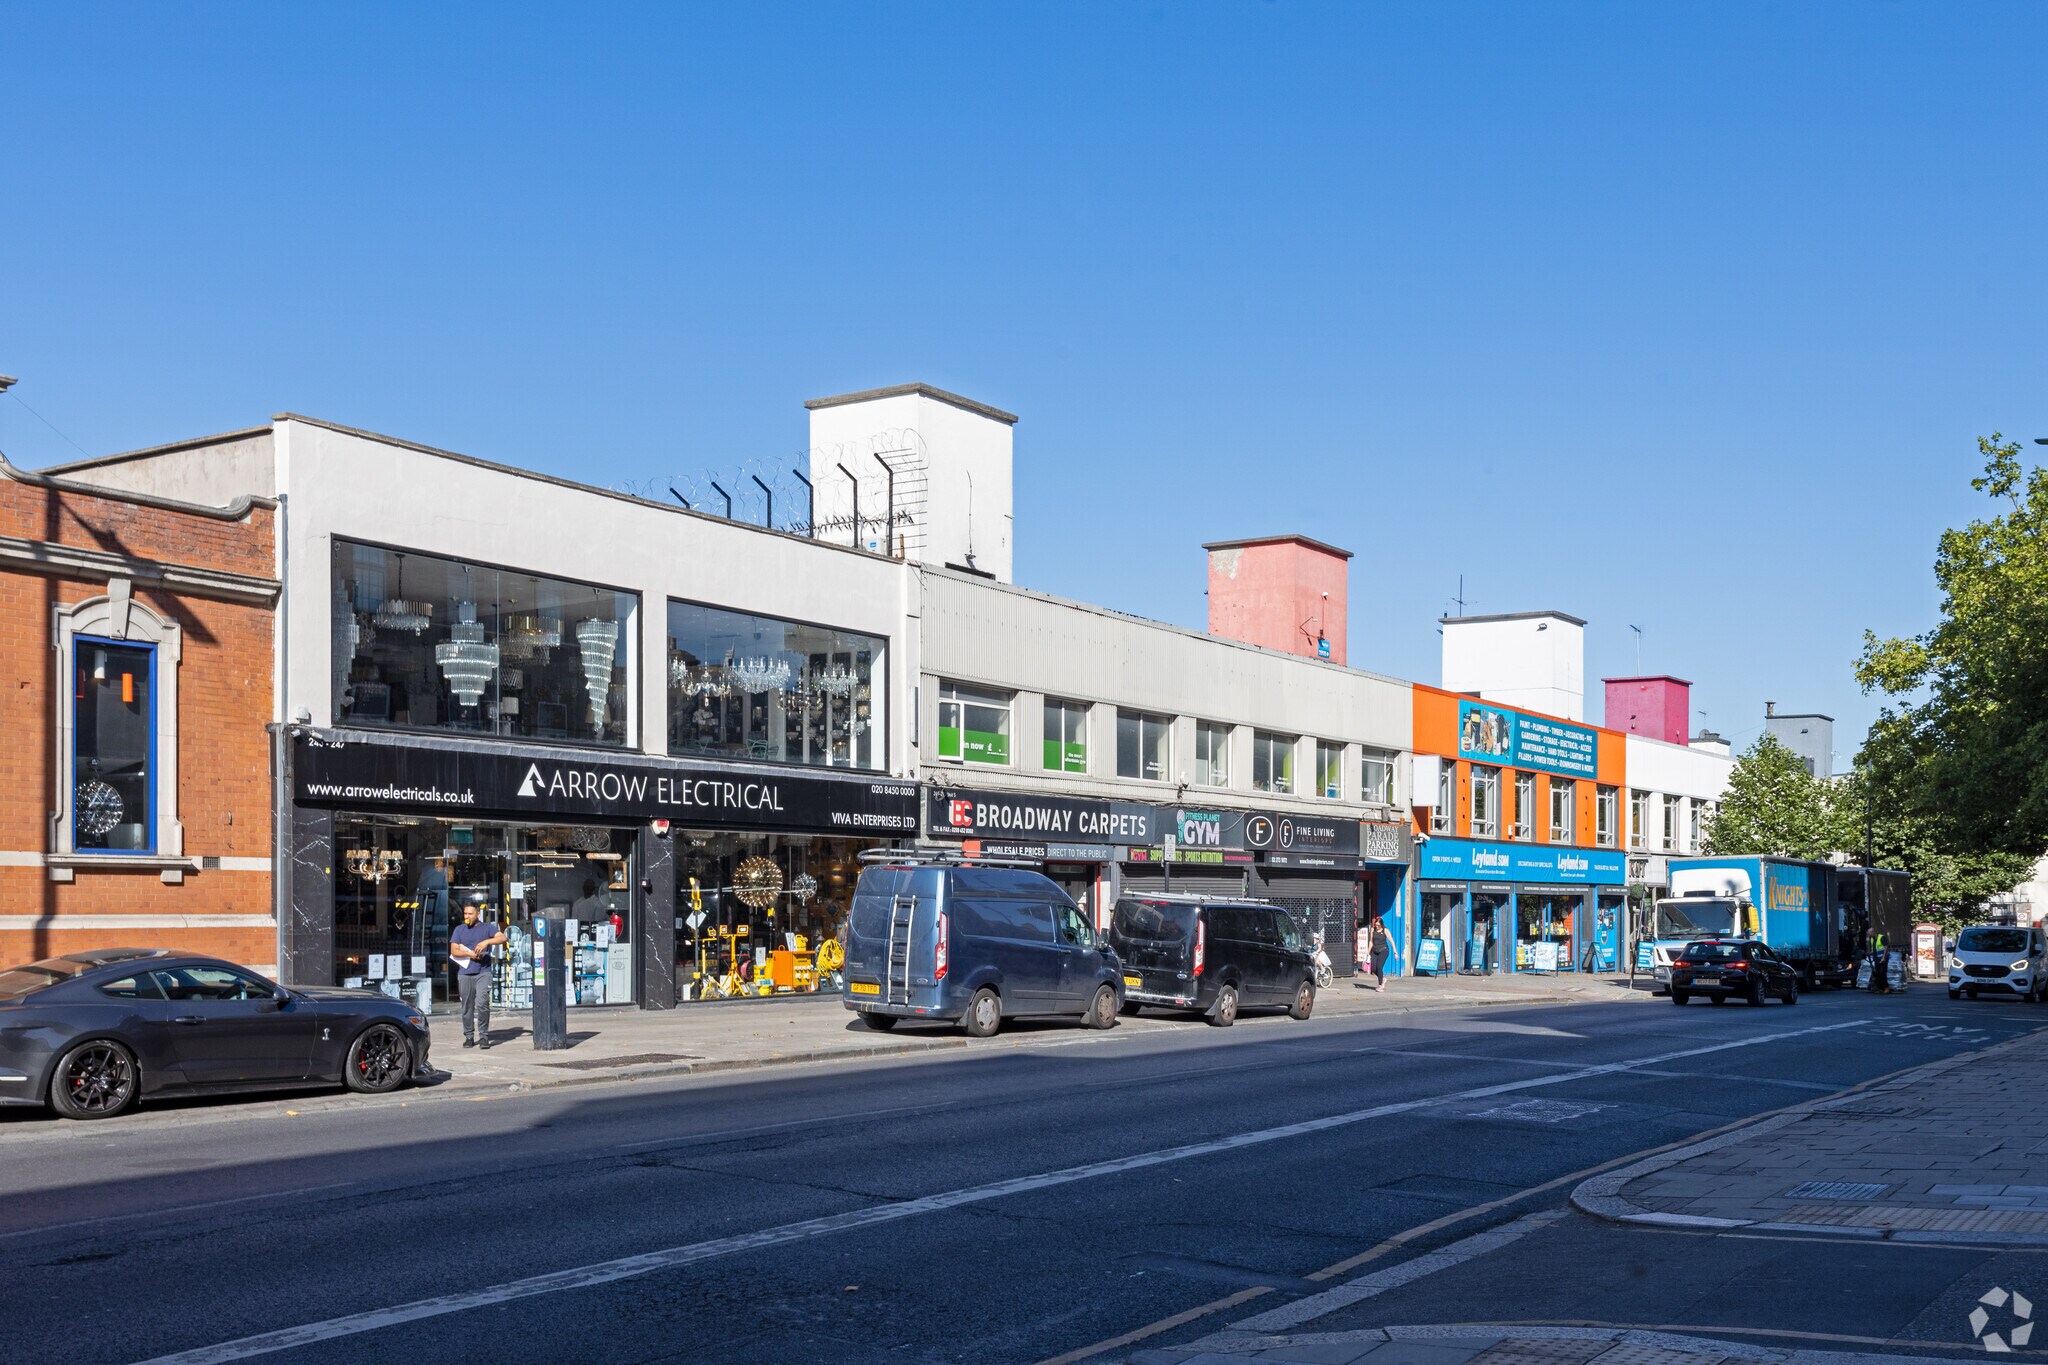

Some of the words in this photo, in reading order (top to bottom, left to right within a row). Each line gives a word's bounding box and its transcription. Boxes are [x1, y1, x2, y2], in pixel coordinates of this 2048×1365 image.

[970, 742, 984, 750] now
[307, 784, 474, 804] www.arrowelectricals.co.uk
[549, 770, 648, 802] ARROW
[658, 778, 784, 810] ELECTRICAL
[871, 784, 883, 794] 020
[884, 786, 899, 795] 8450
[900, 787, 914, 796] 0000
[832, 812, 852, 824] VIVA
[854, 814, 901, 828] ENTERPRISES
[904, 816, 915, 828] LTD
[976, 804, 1072, 832] BROADWAY
[1079, 811, 1146, 836] CARPETS
[1185, 812, 1203, 820] FITNESS
[1204, 812, 1220, 821] PLANET
[1184, 820, 1220, 845] GYM
[1297, 827, 1311, 836] FINE
[1314, 828, 1334, 838] LIVING
[1366, 824, 1399, 833] BOADWAY
[1367, 831, 1399, 841] PARADE
[1367, 840, 1399, 850] PARKING
[987, 845, 1023, 855] WHOLESALE
[1024, 846, 1045, 856] PRICES
[1047, 847, 1067, 857] DIRECT
[1068, 848, 1075, 857] TO
[1076, 849, 1087, 858] THE
[1087, 849, 1106, 859] PUBLIC
[1134, 852, 1147, 861] GYM
[1185, 850, 1200, 862] SPORTS
[1201, 852, 1223, 863] NUTRITION
[1366, 848, 1399, 857] ENTRANCE
[1472, 848, 1498, 868] Leyland
[1558, 854, 1579, 872] Leyland
[1768, 877, 1804, 910] KNIGHTS
